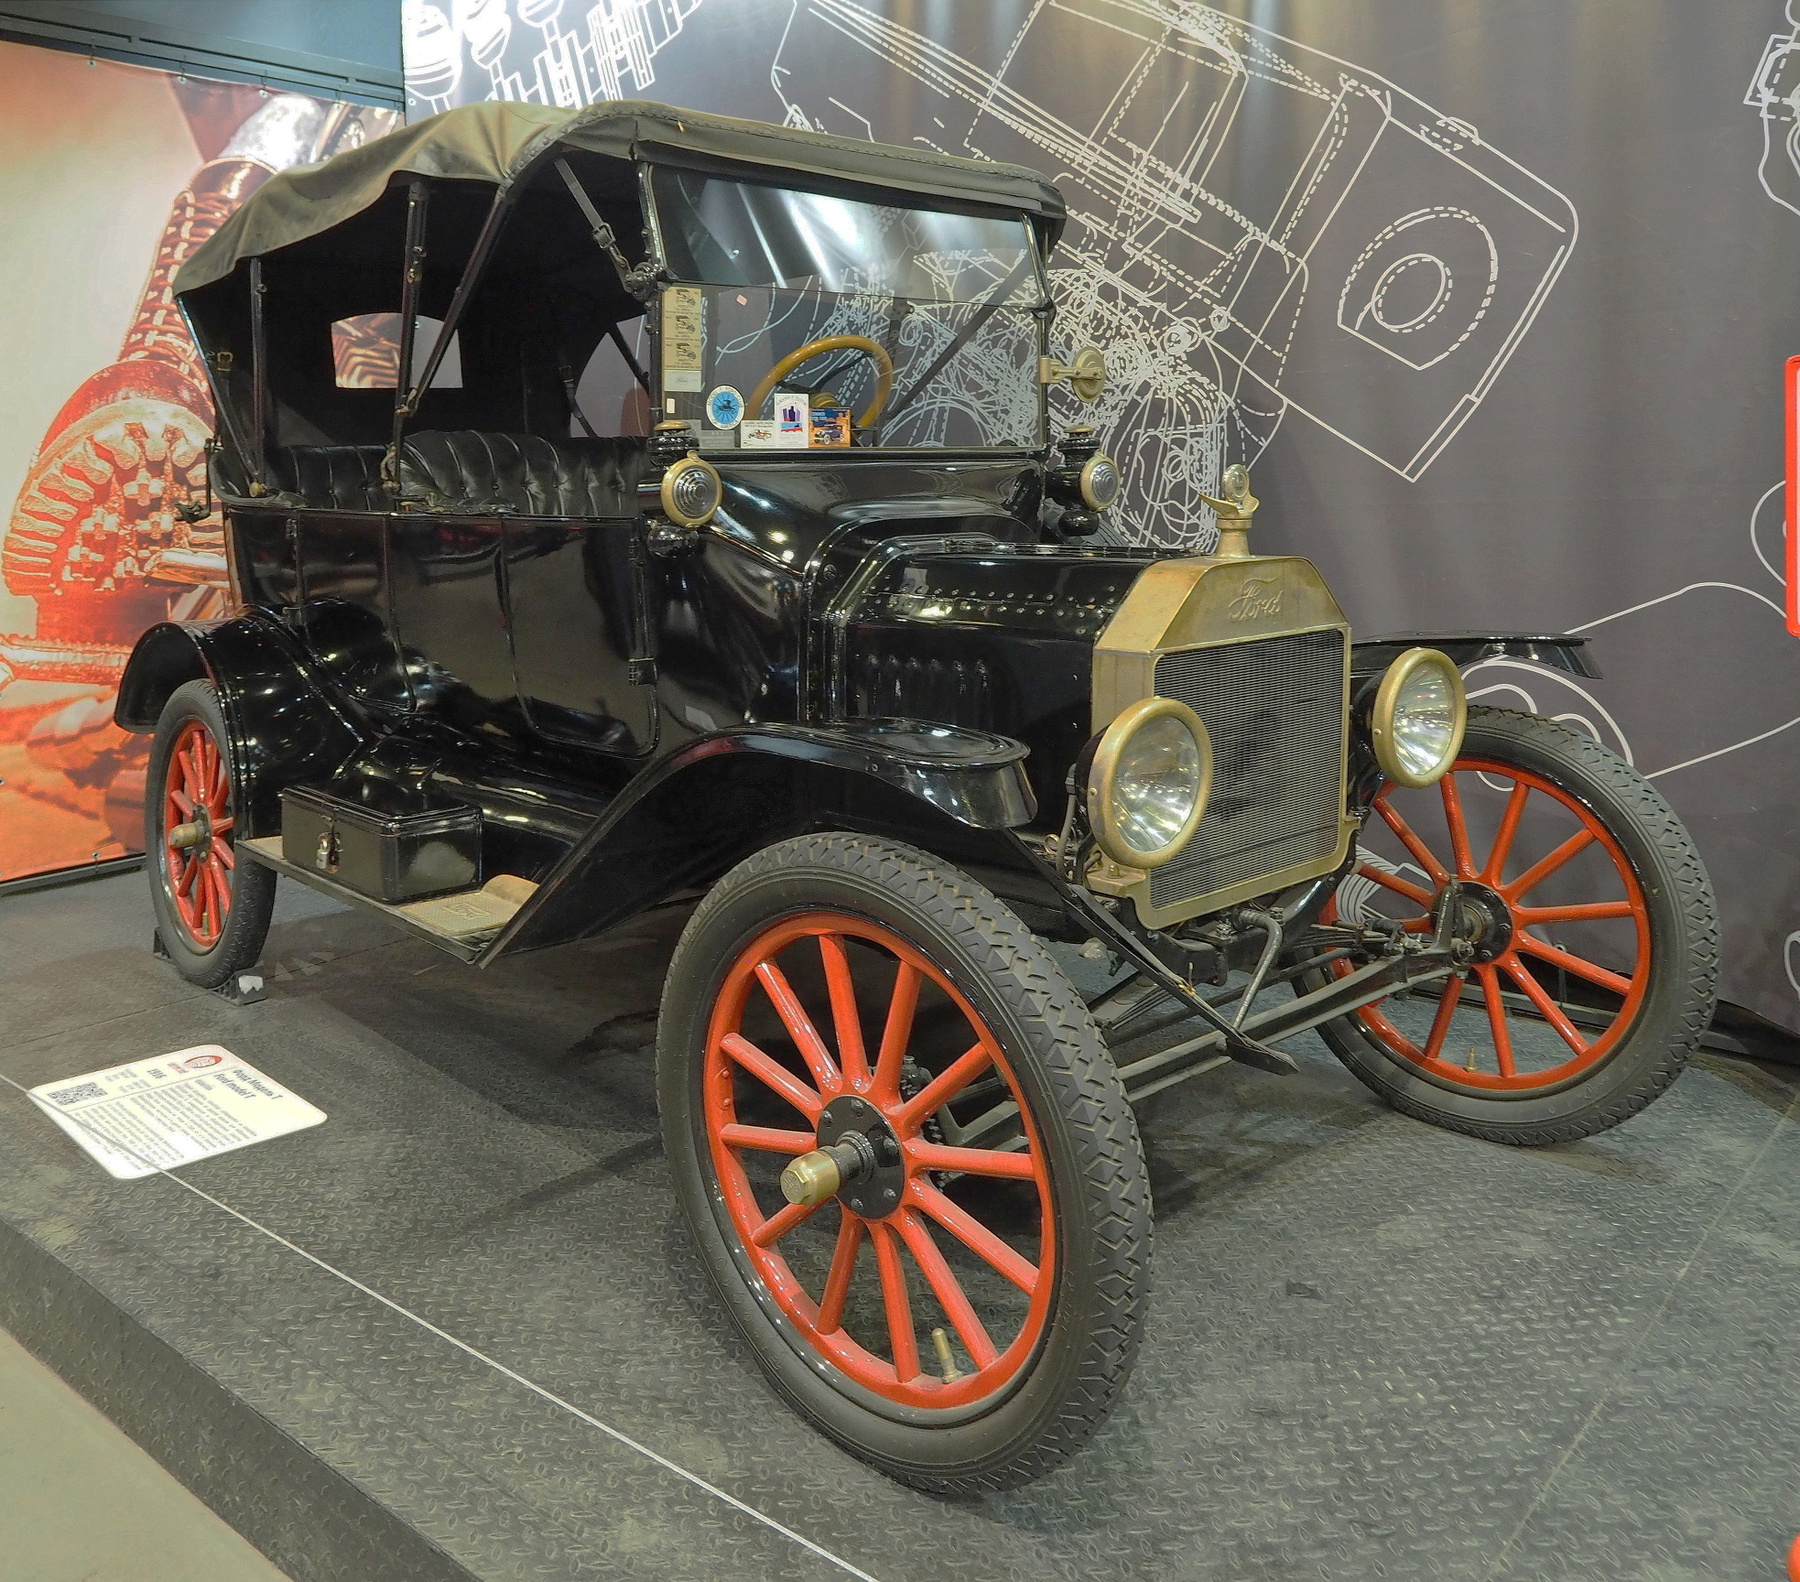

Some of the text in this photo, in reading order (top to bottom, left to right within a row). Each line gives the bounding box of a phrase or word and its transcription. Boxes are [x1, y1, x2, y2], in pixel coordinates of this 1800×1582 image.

[1228, 577, 1285, 622] Ford
[213, 1073, 233, 1085] Ford
[226, 1082, 251, 1096] model
[233, 1069, 251, 1082] Форд
